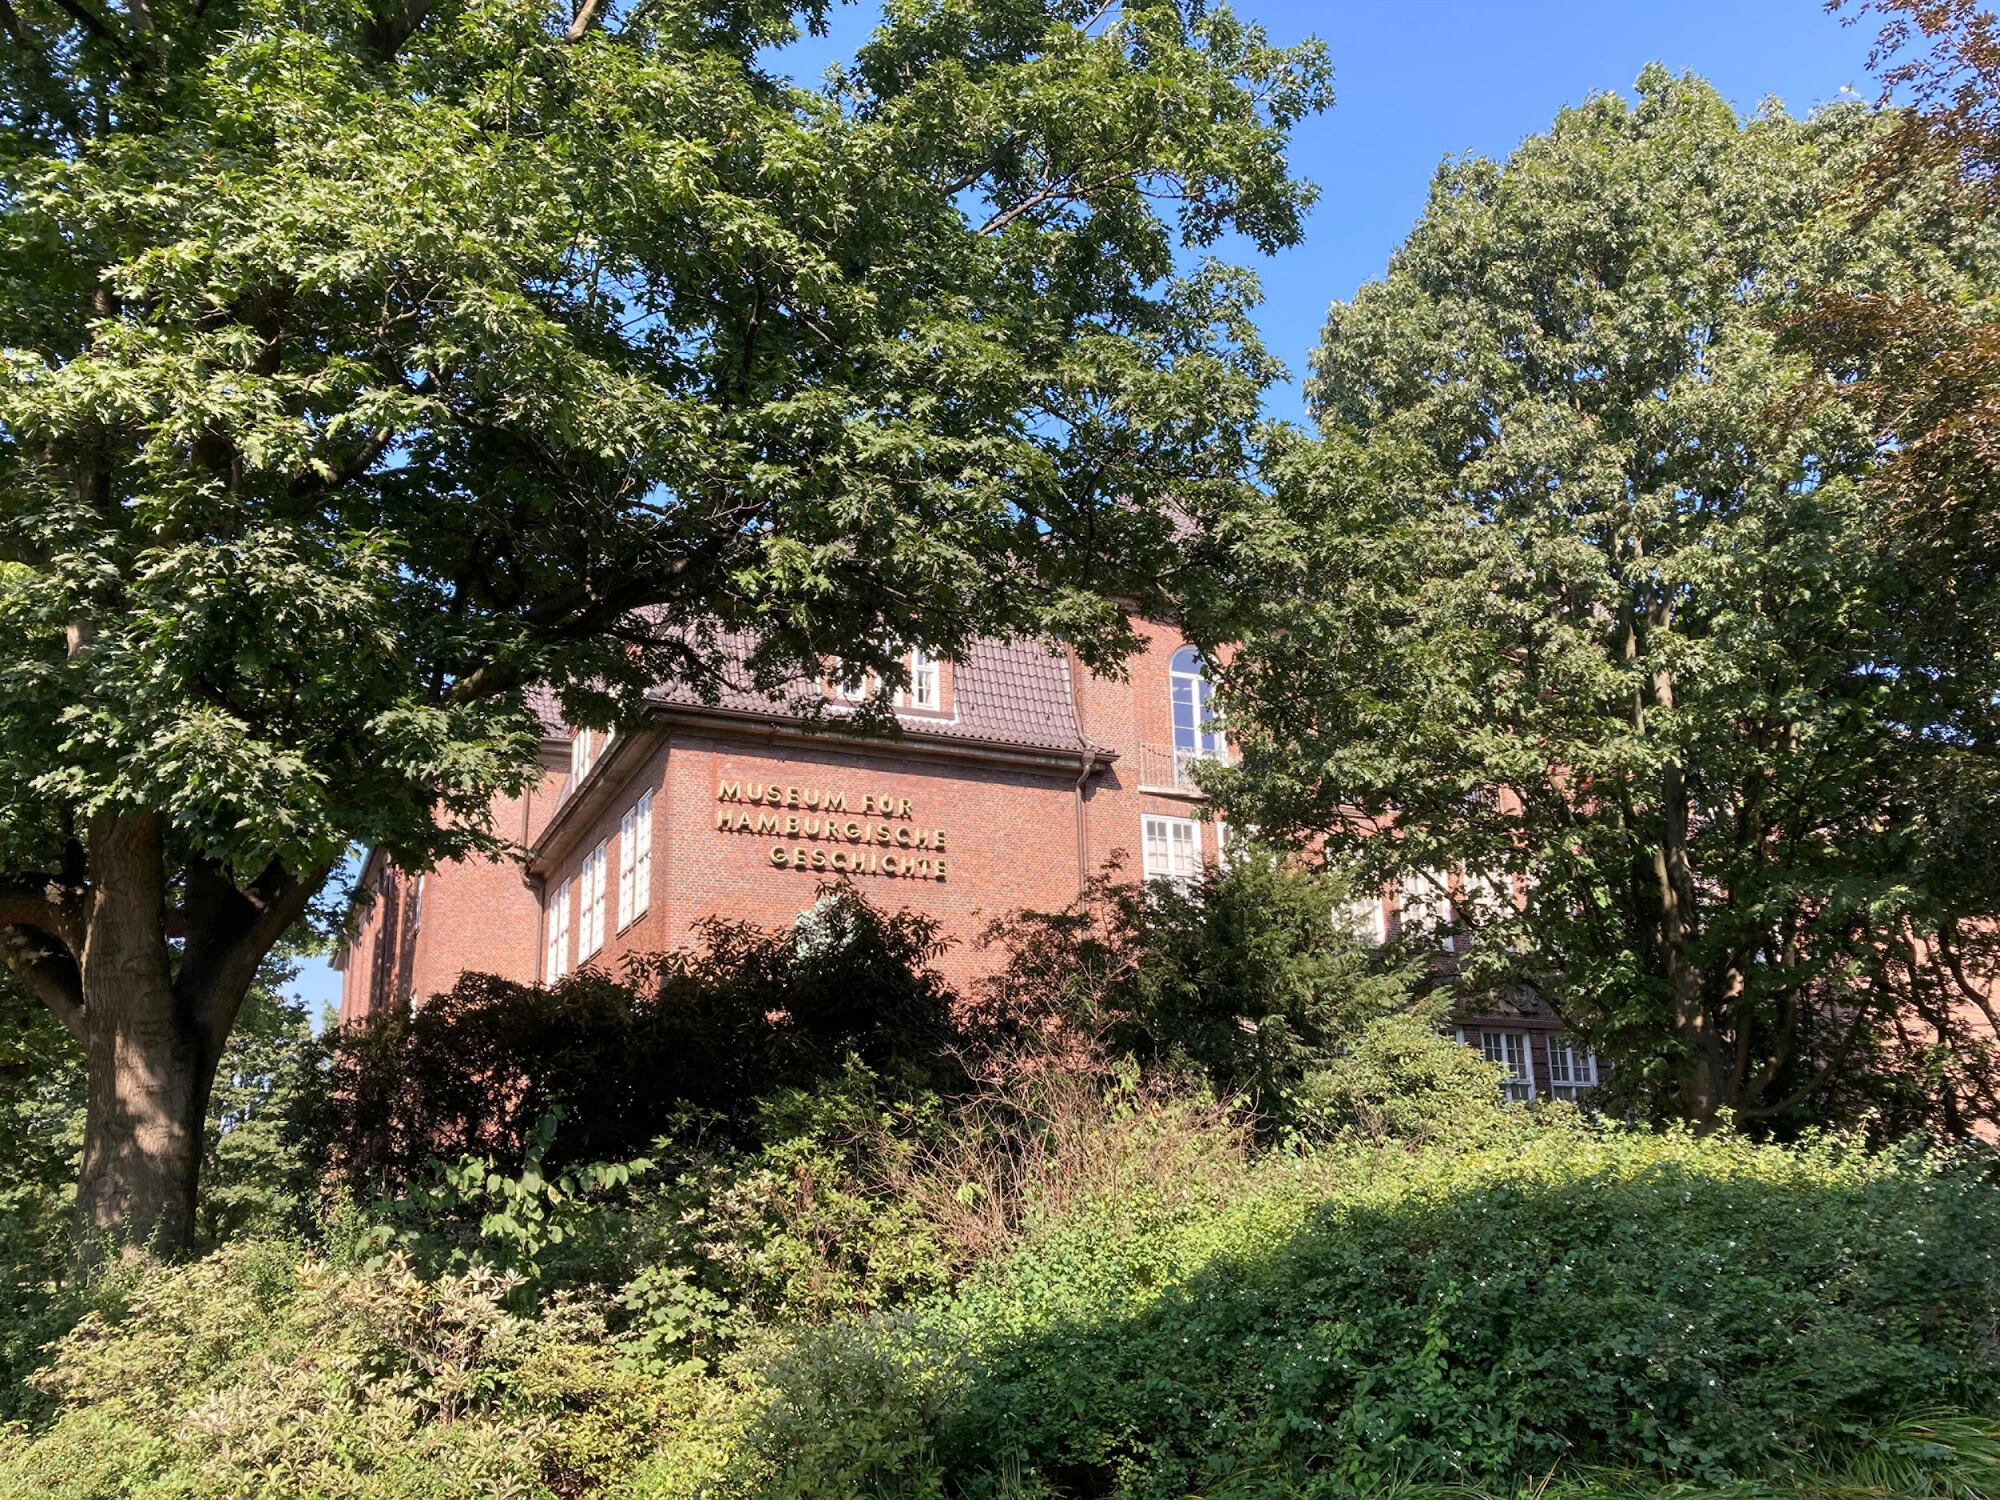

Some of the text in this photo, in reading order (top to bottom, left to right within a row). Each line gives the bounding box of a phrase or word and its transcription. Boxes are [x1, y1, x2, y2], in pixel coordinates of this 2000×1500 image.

[718, 780, 846, 810] MUSEUM
[717, 811, 946, 848] HAMBURGISCHE
[770, 846, 946, 878] GESCHICHTE
